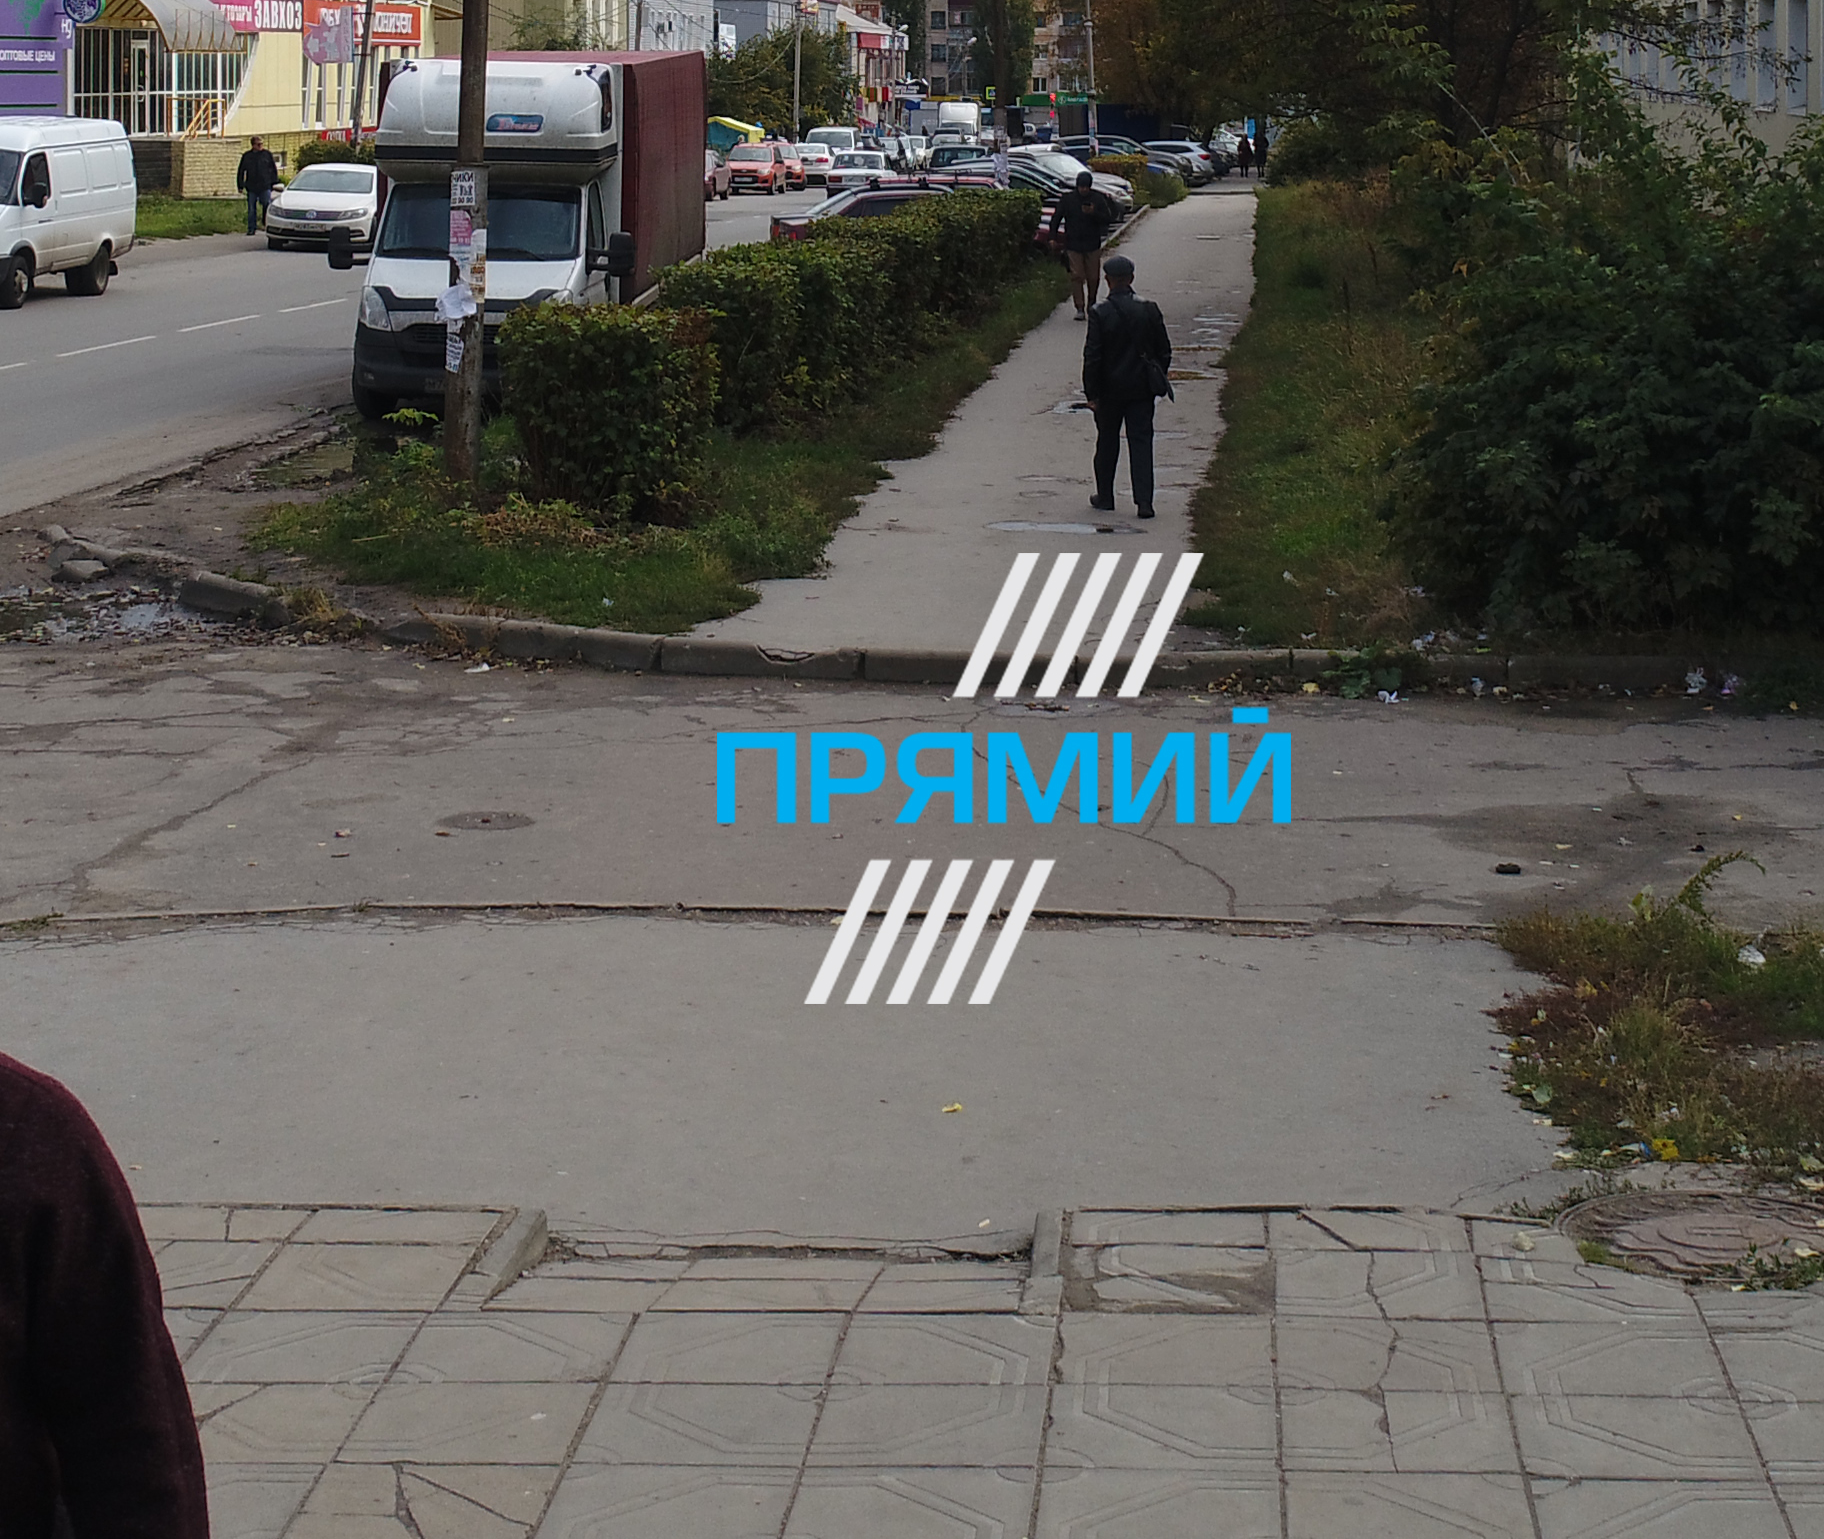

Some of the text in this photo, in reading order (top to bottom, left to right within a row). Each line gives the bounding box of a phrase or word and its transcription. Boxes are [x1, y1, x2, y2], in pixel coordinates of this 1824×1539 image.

[254, 0, 302, 30] ЗАВХОЗ
[0, 50, 55, 62] ОПТОВЫЕ ЦЕНЫ
